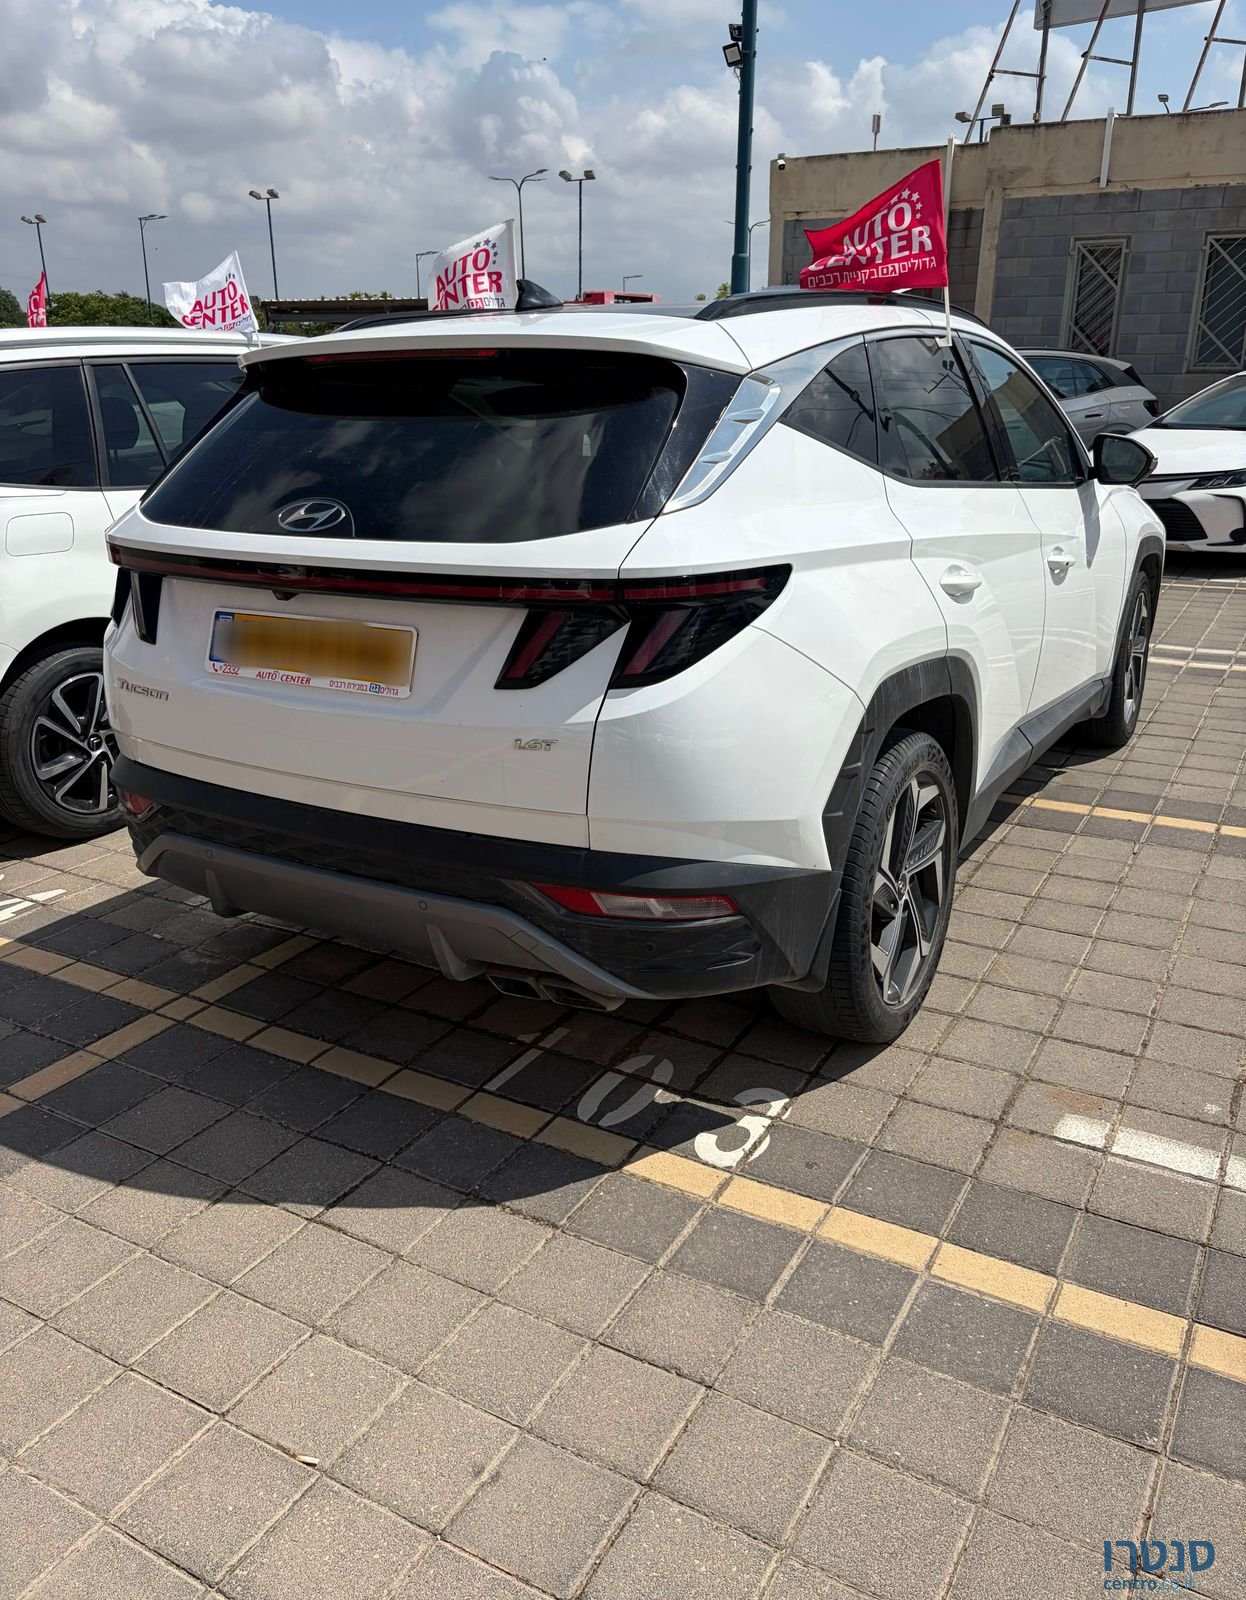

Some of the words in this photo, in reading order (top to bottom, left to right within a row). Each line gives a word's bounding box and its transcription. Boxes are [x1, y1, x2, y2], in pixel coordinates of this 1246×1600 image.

[842, 201, 912, 257] AUTO
[807, 225, 933, 272] CENTER
[879, 263, 898, 277] גם
[900, 256, 937, 274] גדולים
[436, 248, 491, 301] AUTO
[807, 272, 841, 288] רכבים
[843, 268, 877, 285] בקניית
[189, 280, 238, 315] AUTO
[181, 293, 249, 330] CENTER
[256, 671, 278, 681] AUTO
[280, 674, 312, 685] CENTER
[329, 679, 346, 689] רכבים
[379, 686, 399, 696] גדולים
[512, 738, 560, 752] 1.6T
[484, 1027, 794, 1168] 103
